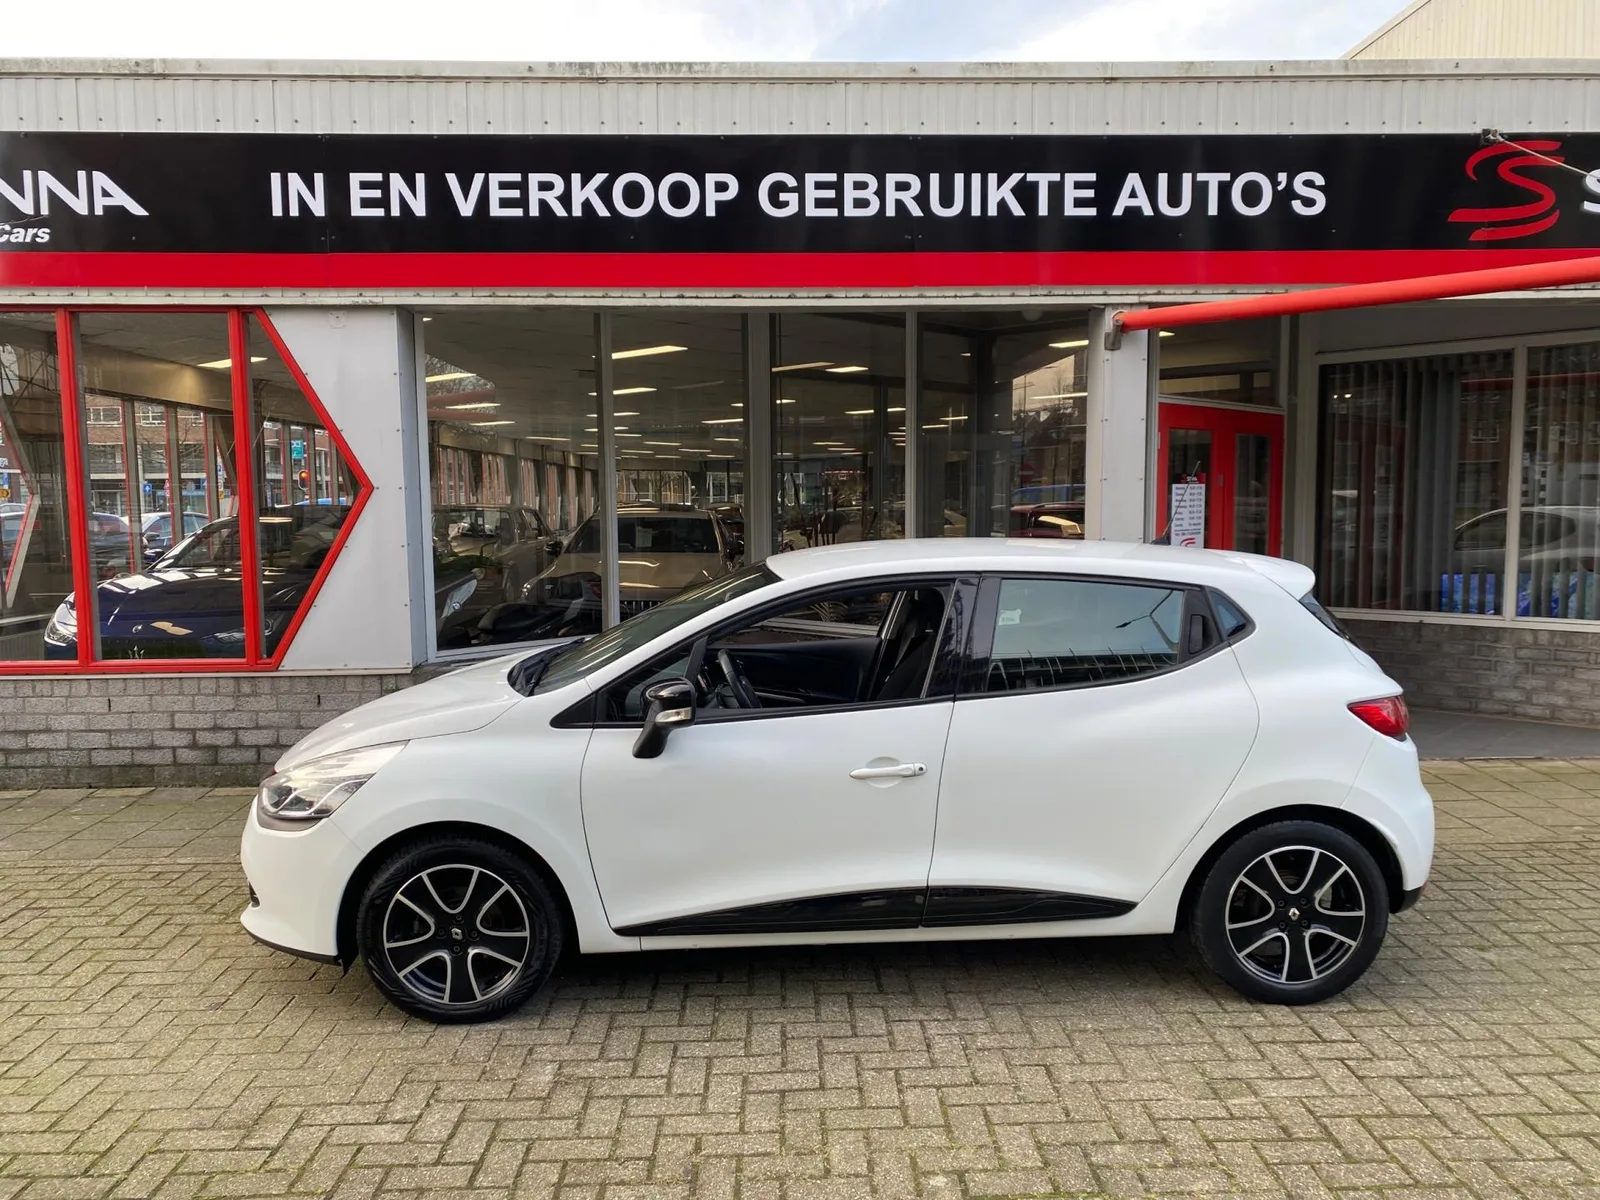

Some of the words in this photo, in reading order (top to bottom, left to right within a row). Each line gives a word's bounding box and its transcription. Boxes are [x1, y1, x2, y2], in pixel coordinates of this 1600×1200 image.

[270, 172, 326, 217] IN
[349, 172, 427, 217] EN
[444, 172, 739, 218] VERKOOP
[758, 172, 1097, 218] GEBRUIKTE
[1111, 171, 1327, 217] AUTO’S
[0, 223, 51, 243] Cars
